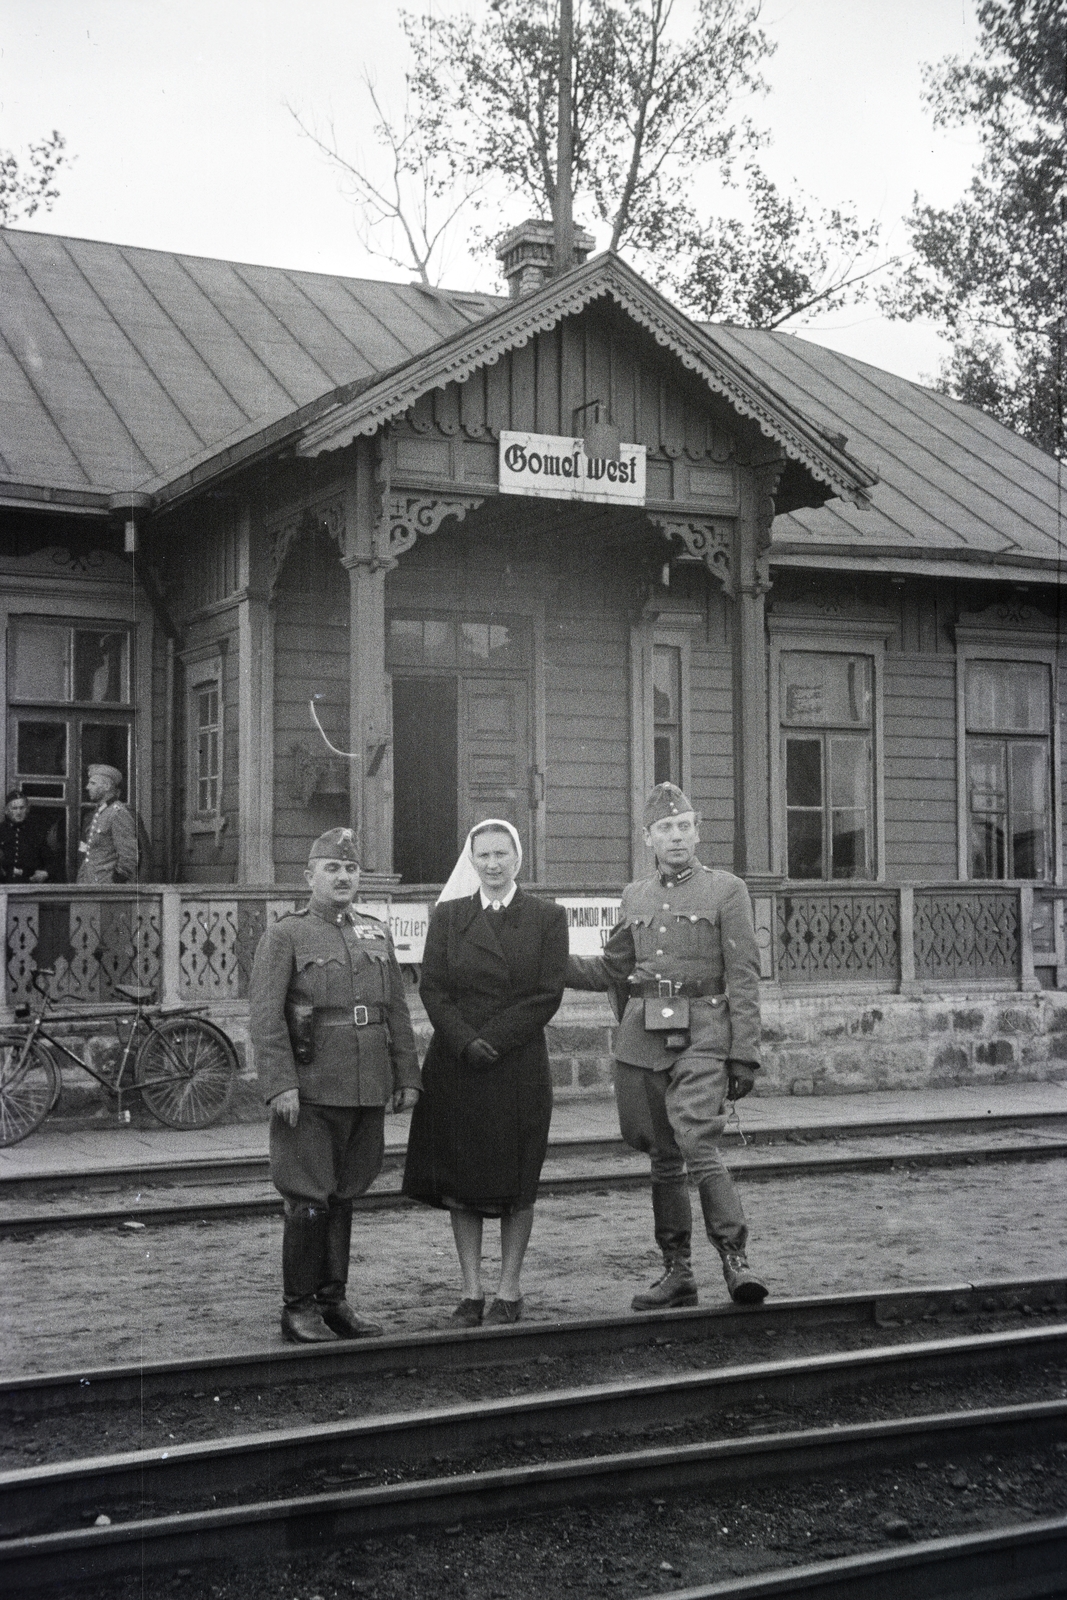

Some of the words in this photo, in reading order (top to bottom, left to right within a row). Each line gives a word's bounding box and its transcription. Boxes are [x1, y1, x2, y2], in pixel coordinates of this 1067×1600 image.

[504, 443, 580, 479] Gomel
[388, 916, 427, 937] ffizier
[566, 907, 599, 927] OMANDO
